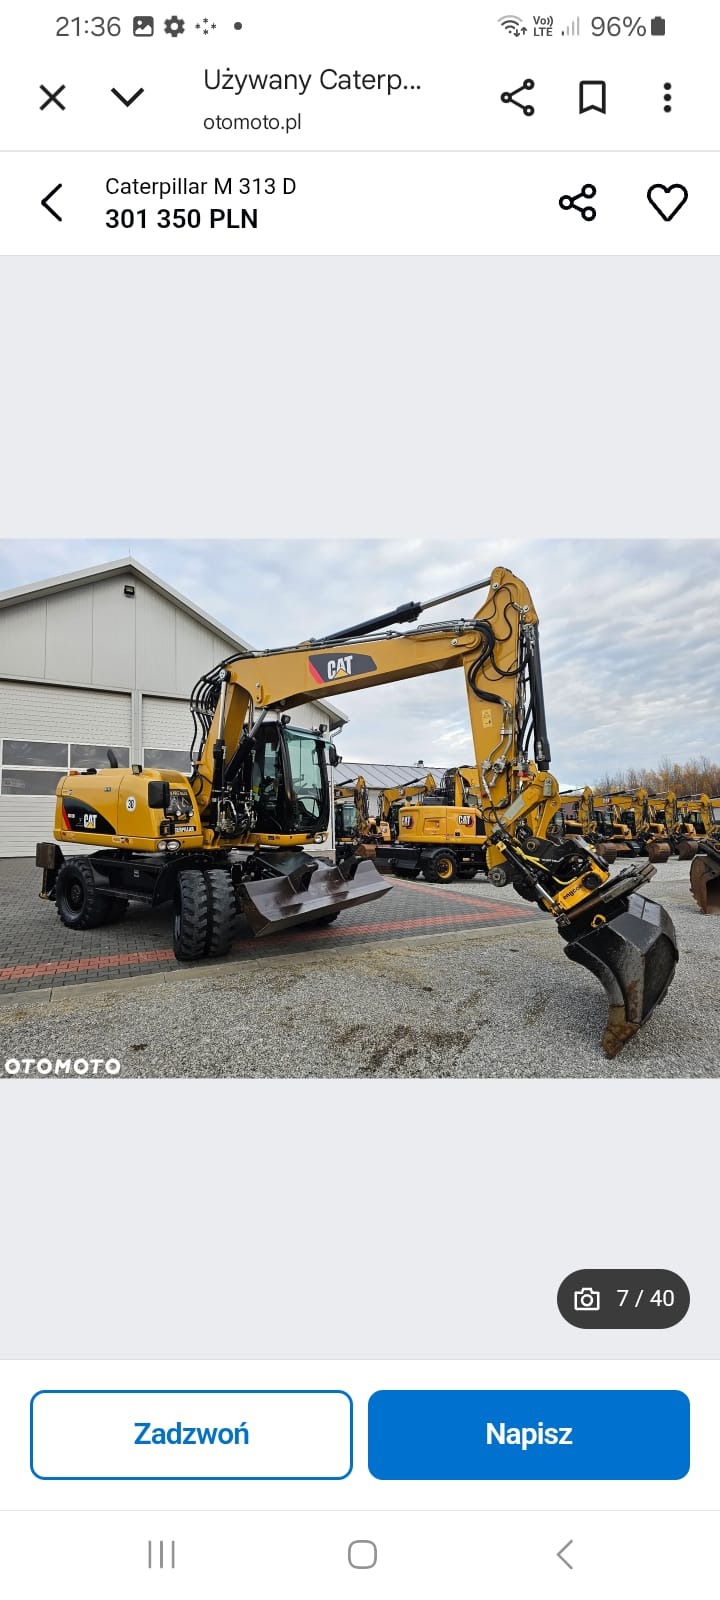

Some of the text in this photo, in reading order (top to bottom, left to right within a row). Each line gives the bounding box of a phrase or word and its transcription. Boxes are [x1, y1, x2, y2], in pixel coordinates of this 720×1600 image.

[56, 16, 121, 36] 21:36
[533, 26, 553, 36] LTE
[591, 16, 646, 36] 96%
[204, 66, 422, 96] Używany Caterp...
[203, 112, 302, 134] otomoto.pl
[105, 176, 297, 200] Caterpillar M 313 D
[105, 208, 258, 229] 301 350 PLN
[327, 655, 353, 680] CAT
[83, 813, 98, 829] CAT
[458, 815, 471, 825] CAT
[616, 1289, 675, 1308] 7 / 40
[133, 1421, 250, 1445] Zadzwoń
[486, 1421, 574, 1451] Napisz
